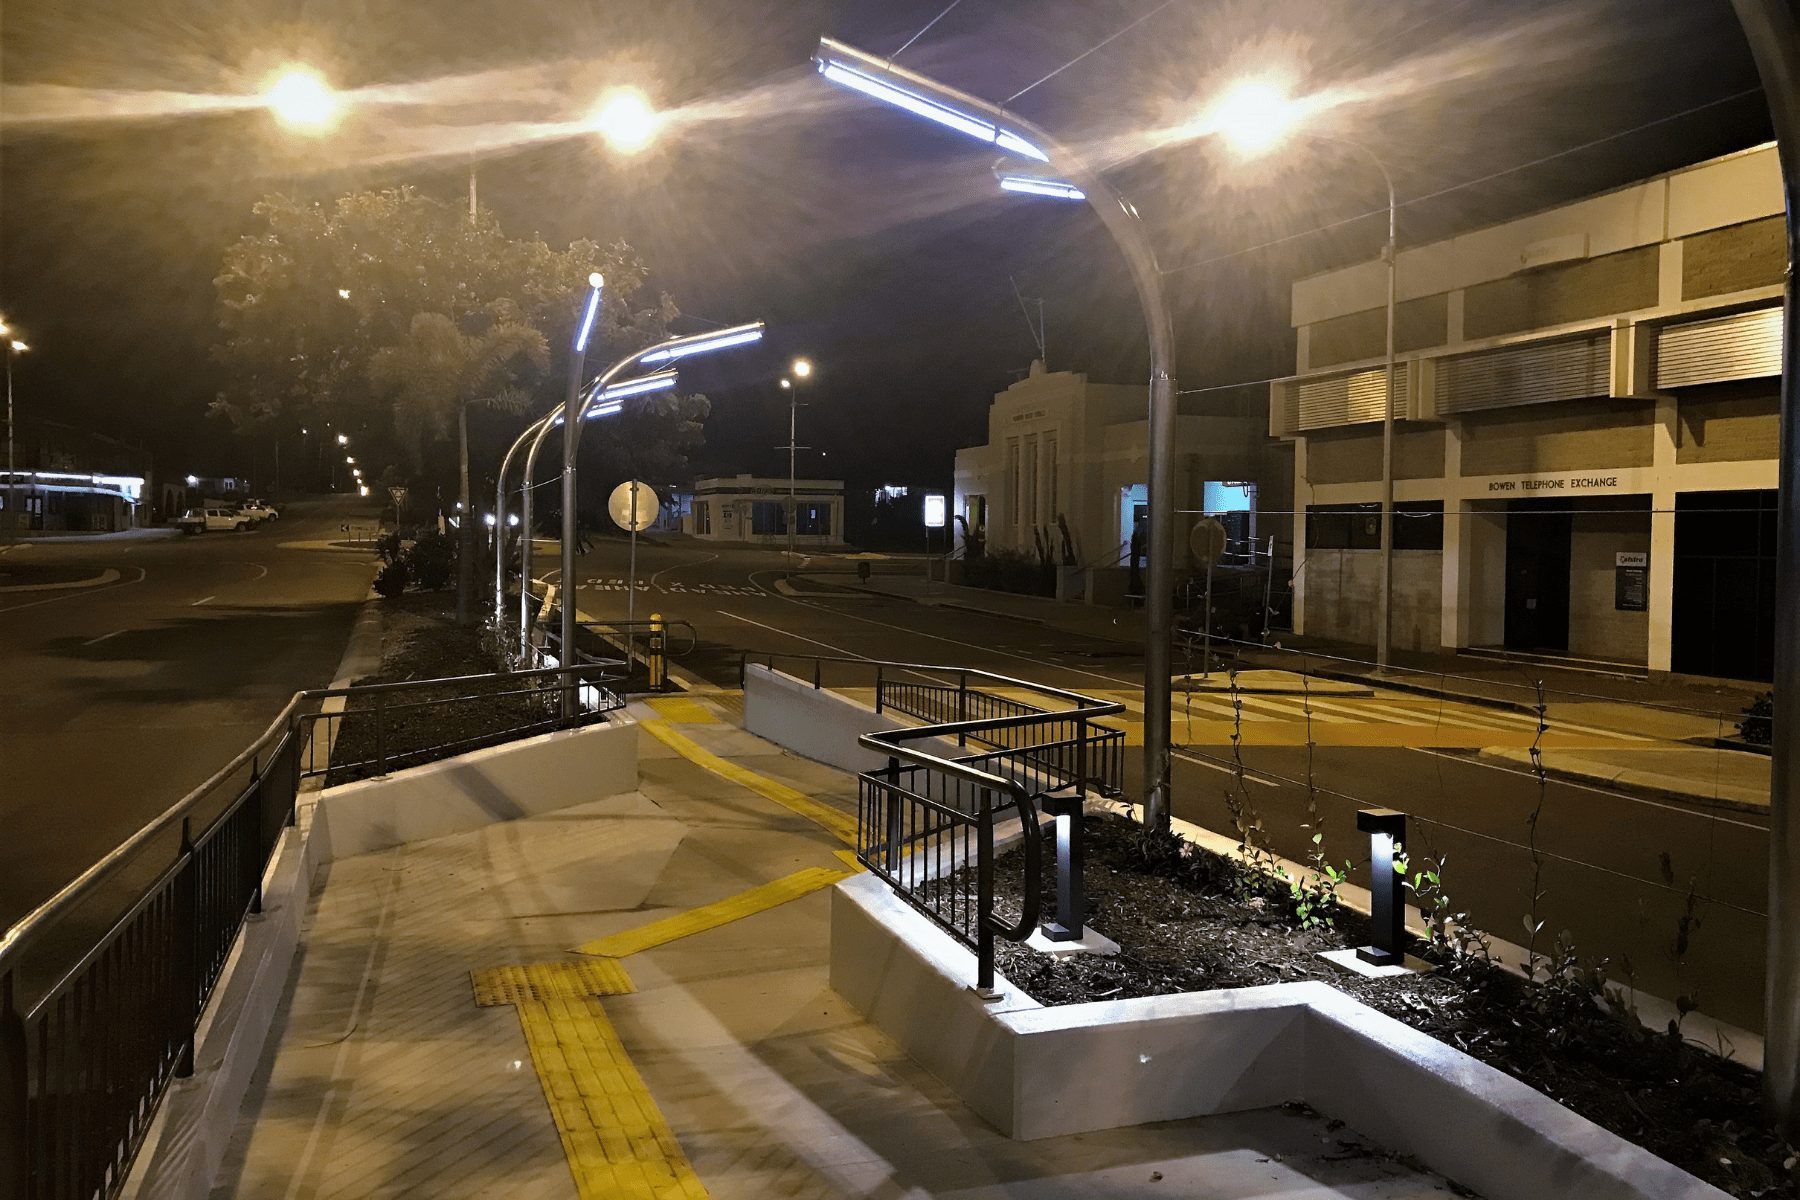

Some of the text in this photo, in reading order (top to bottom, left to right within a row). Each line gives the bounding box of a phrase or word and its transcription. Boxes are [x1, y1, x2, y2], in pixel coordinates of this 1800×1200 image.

[1488, 477, 1617, 491] BOWEN TELEPHONE EXCHANGE
